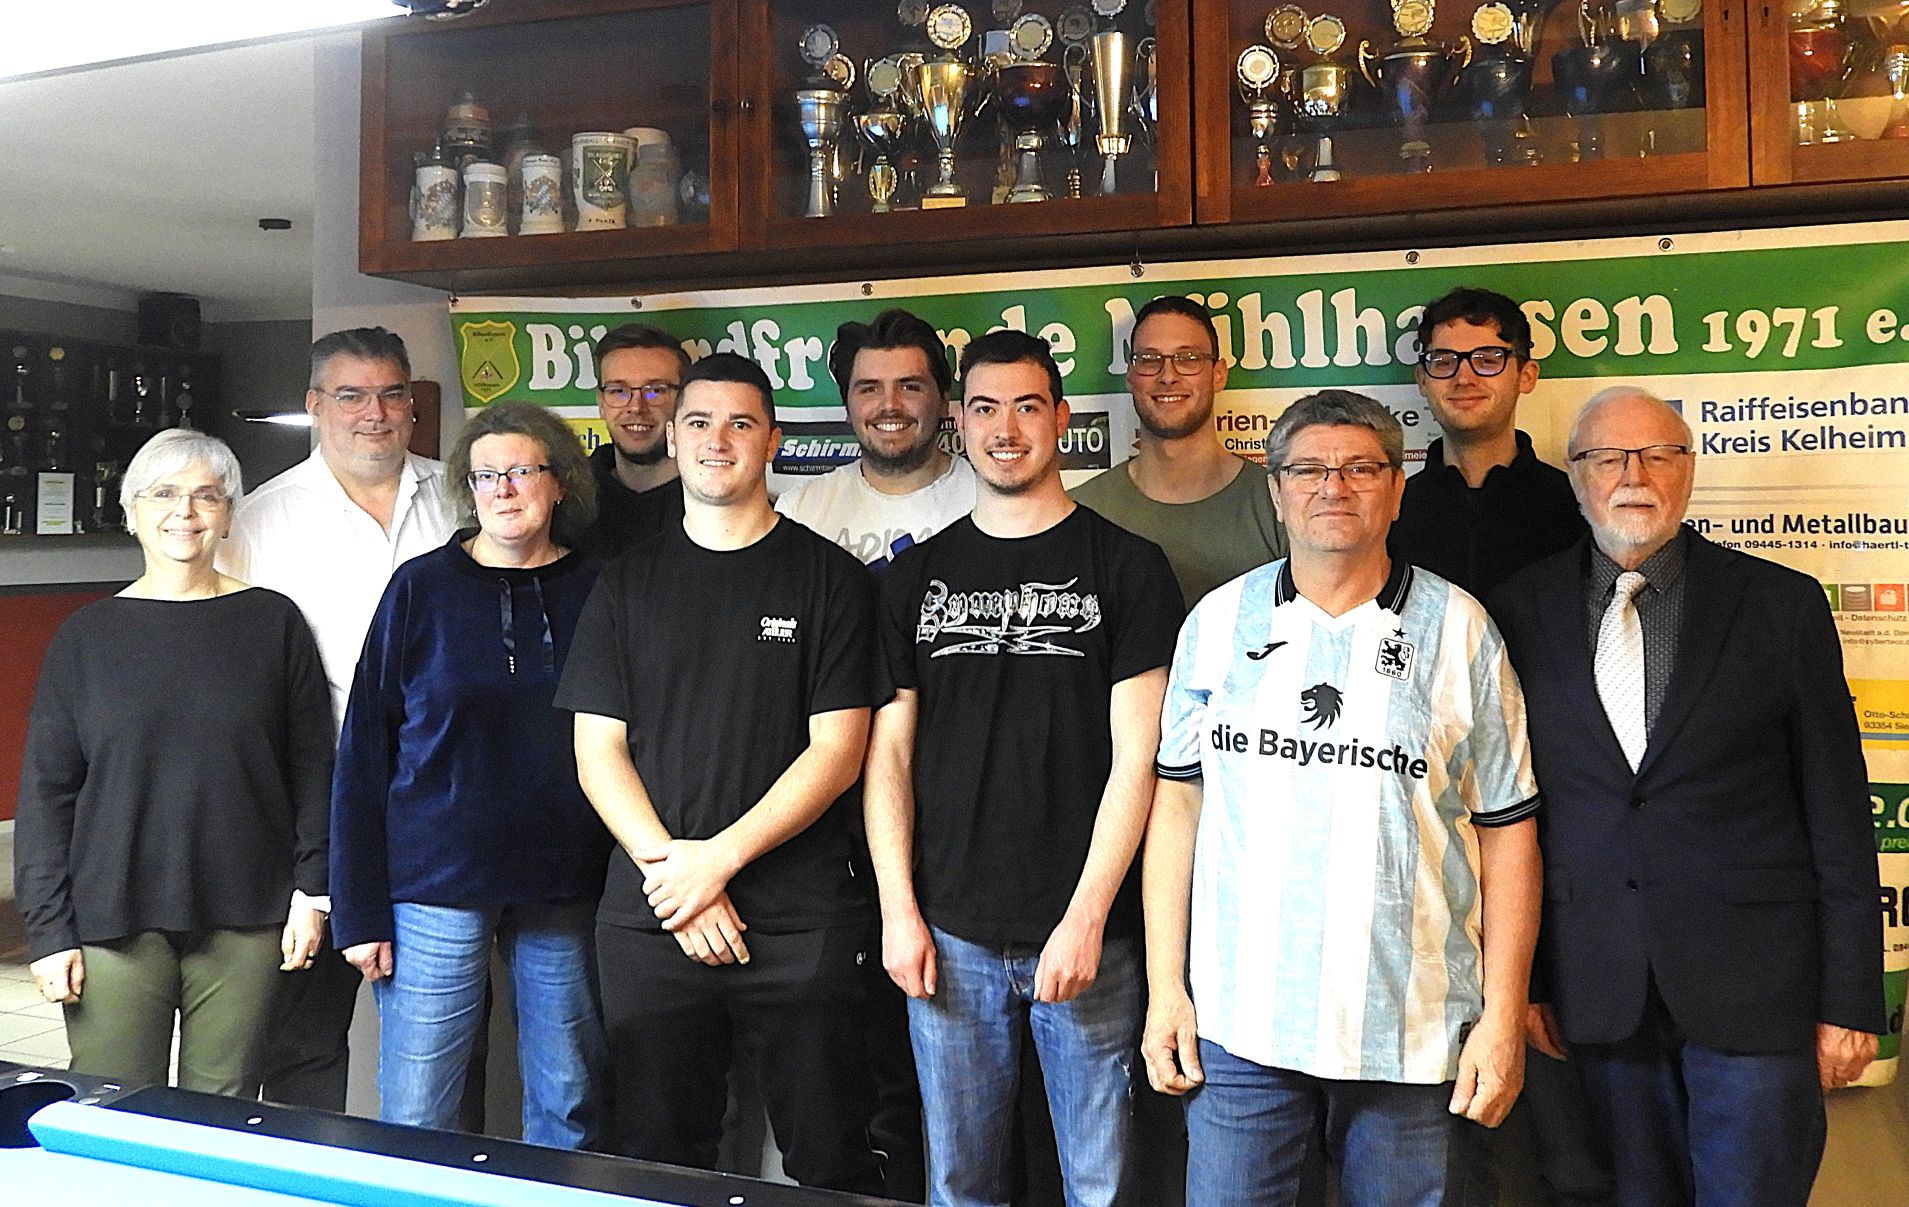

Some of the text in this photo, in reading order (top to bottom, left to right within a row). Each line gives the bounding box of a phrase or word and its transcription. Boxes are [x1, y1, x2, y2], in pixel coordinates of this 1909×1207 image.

[1702, 306, 1843, 359] 1971
[1701, 392, 1909, 423] Raiffeisenban
[781, 439, 862, 457] Schirm
[1702, 424, 1906, 455] Kreis Kelheim
[1731, 514, 1774, 534] und
[1782, 513, 1908, 534] Metallbau
[1744, 540, 1818, 549] 09445-1314
[1382, 667, 1402, 677] 1860
[1211, 723, 1428, 779] die Bayerische
